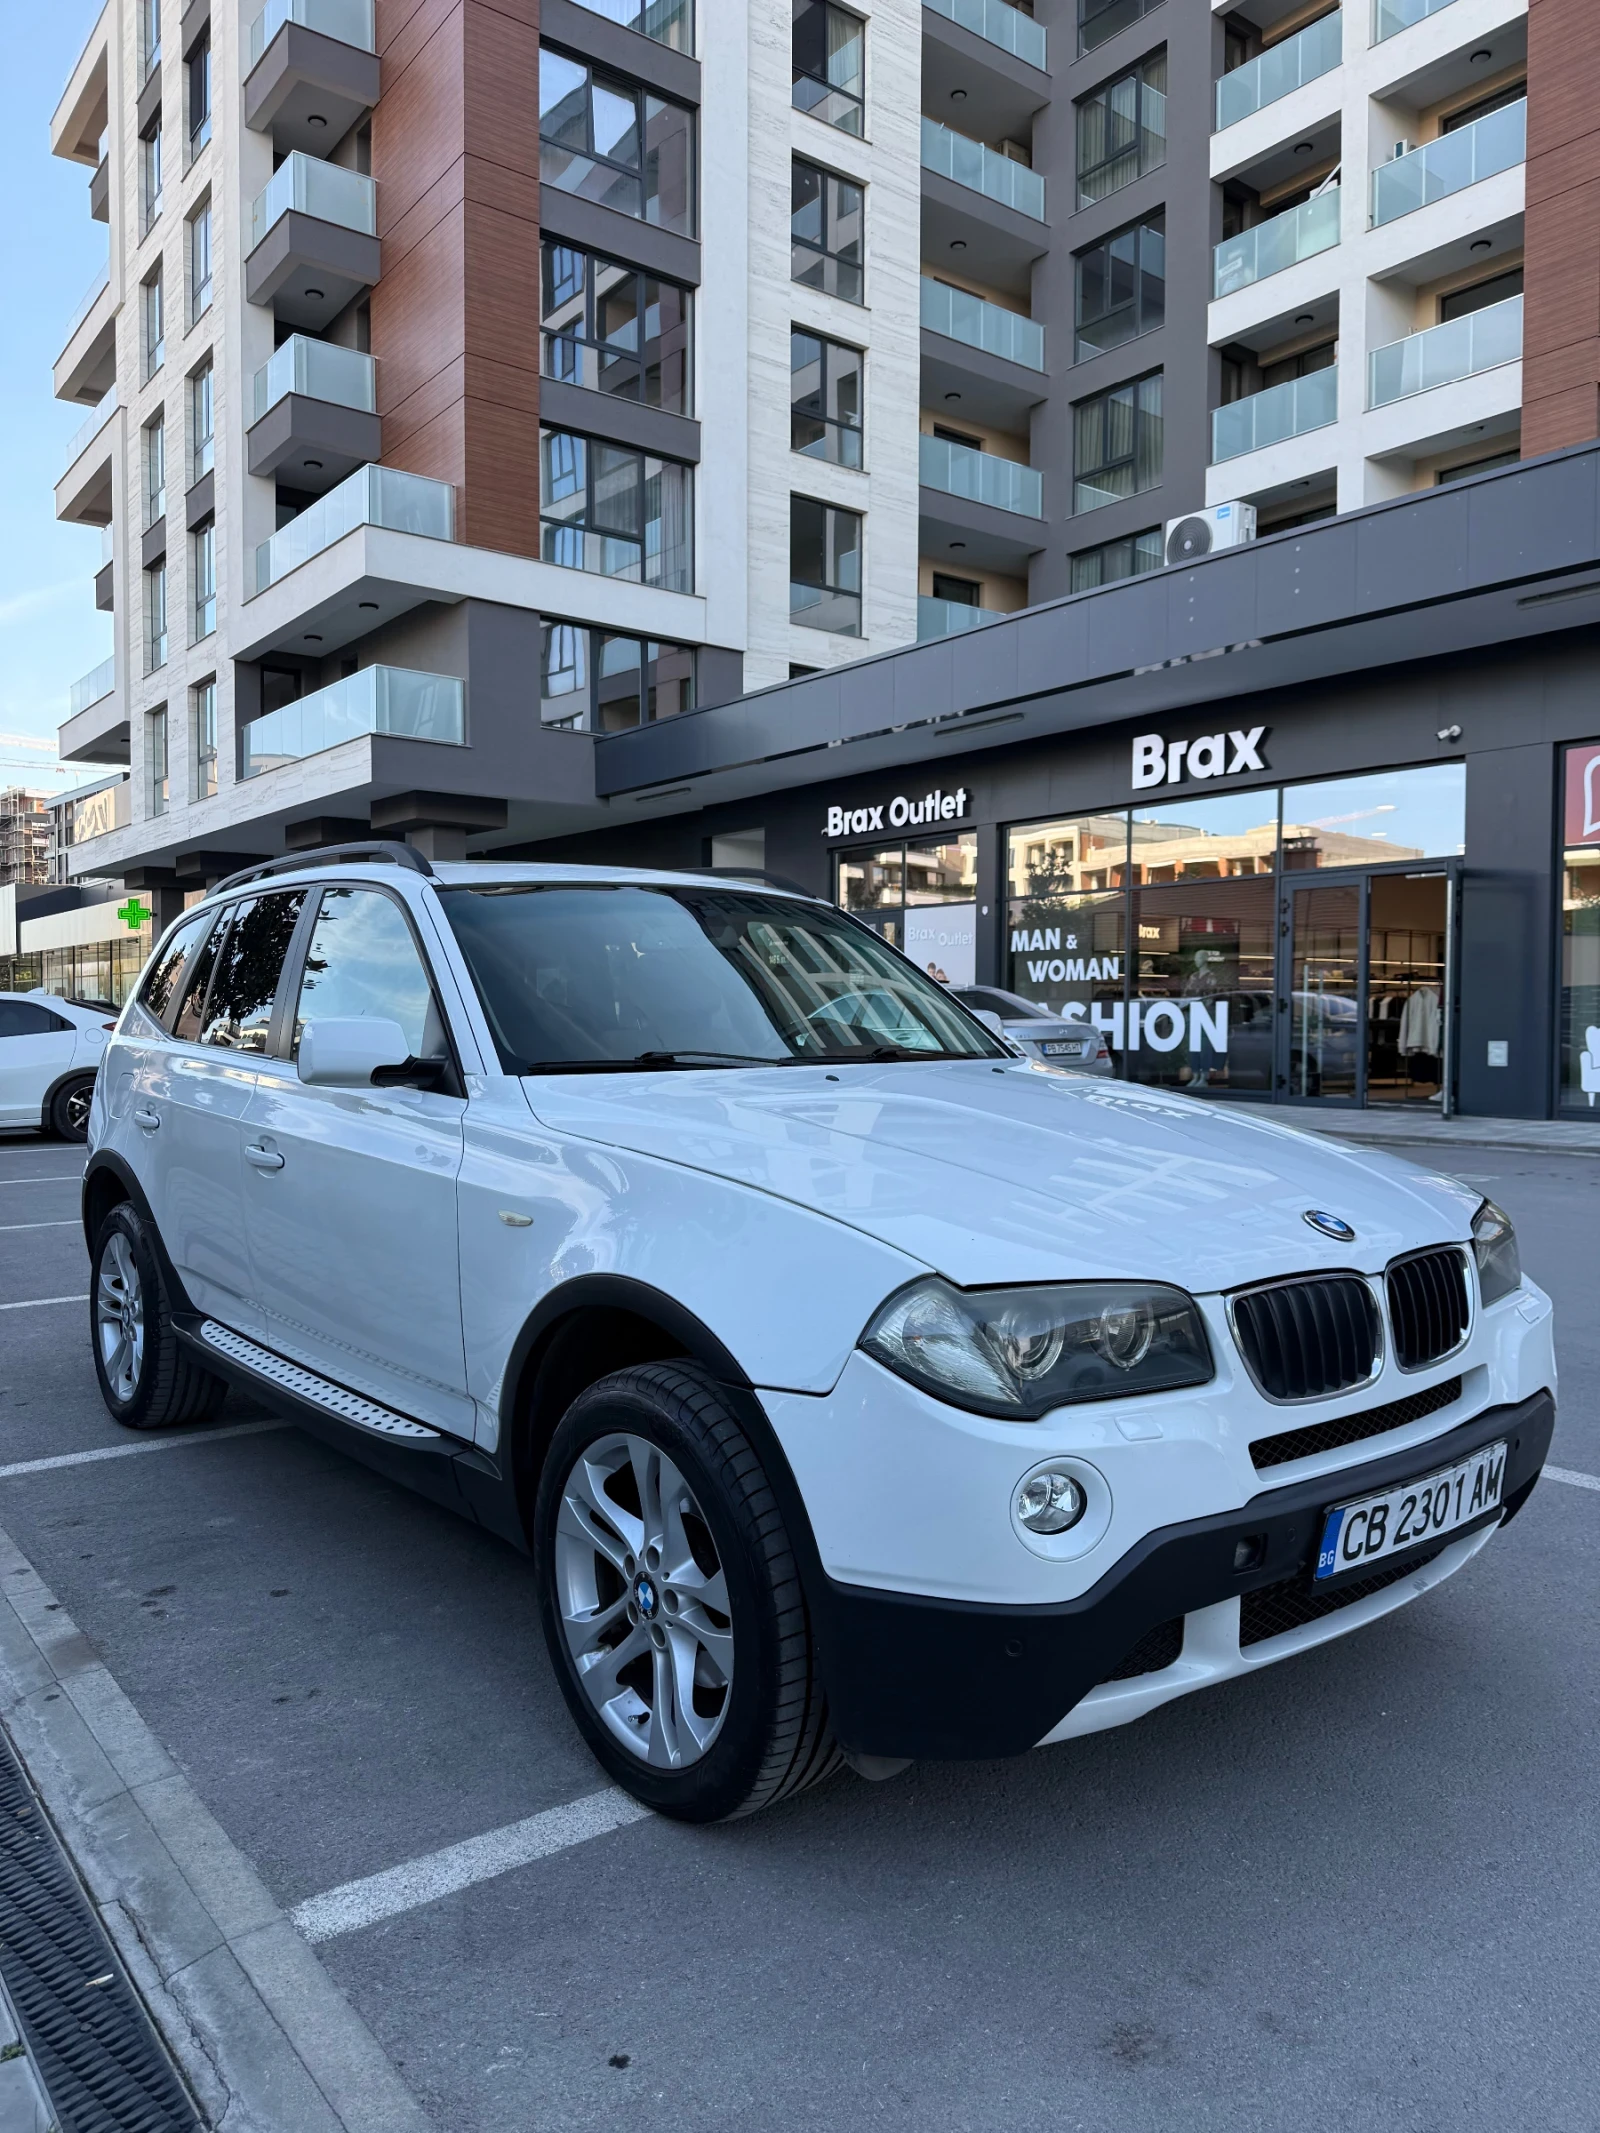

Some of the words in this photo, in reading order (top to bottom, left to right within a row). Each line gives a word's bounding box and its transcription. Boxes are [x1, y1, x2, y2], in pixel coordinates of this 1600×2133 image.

[1132, 726, 1266, 790] Brax
[828, 805, 884, 837] Brax
[889, 787, 967, 827] Outlet
[908, 926, 936, 941] Brax
[939, 931, 973, 946] Outlet
[1011, 928, 1061, 952] MAN
[1066, 934, 1078, 949] &
[1027, 957, 1119, 982] WOMAN
[1342, 1504, 1389, 1561] CB
[1393, 1473, 1466, 1546] 2301
[1469, 1454, 1504, 1514] AM
[1318, 1550, 1335, 1568] BG
